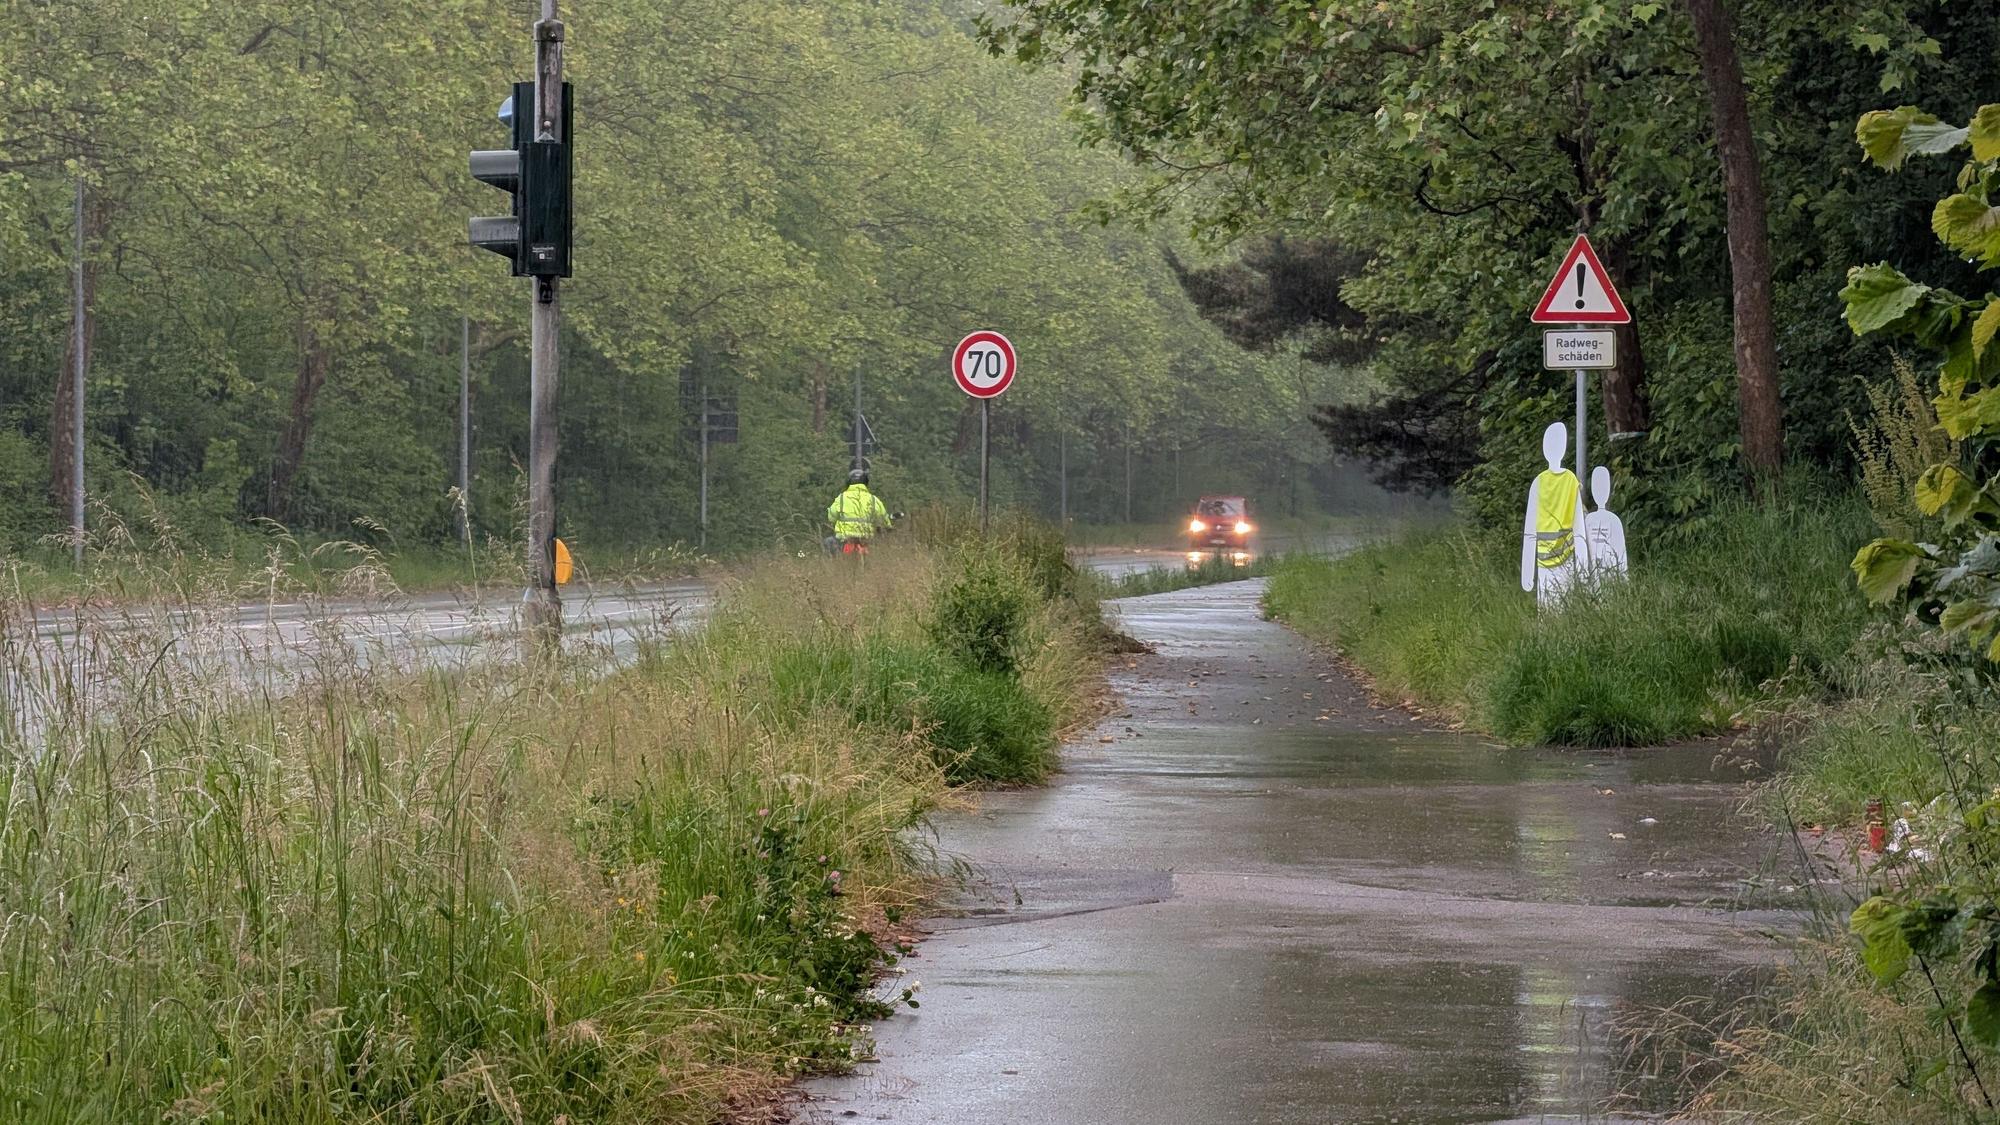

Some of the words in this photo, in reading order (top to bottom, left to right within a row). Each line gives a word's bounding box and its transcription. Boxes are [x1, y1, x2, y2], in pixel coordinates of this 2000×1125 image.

[1556, 338, 1604, 350] Radweg-
[1558, 351, 1602, 361] schäden
[968, 350, 1001, 379] 70
